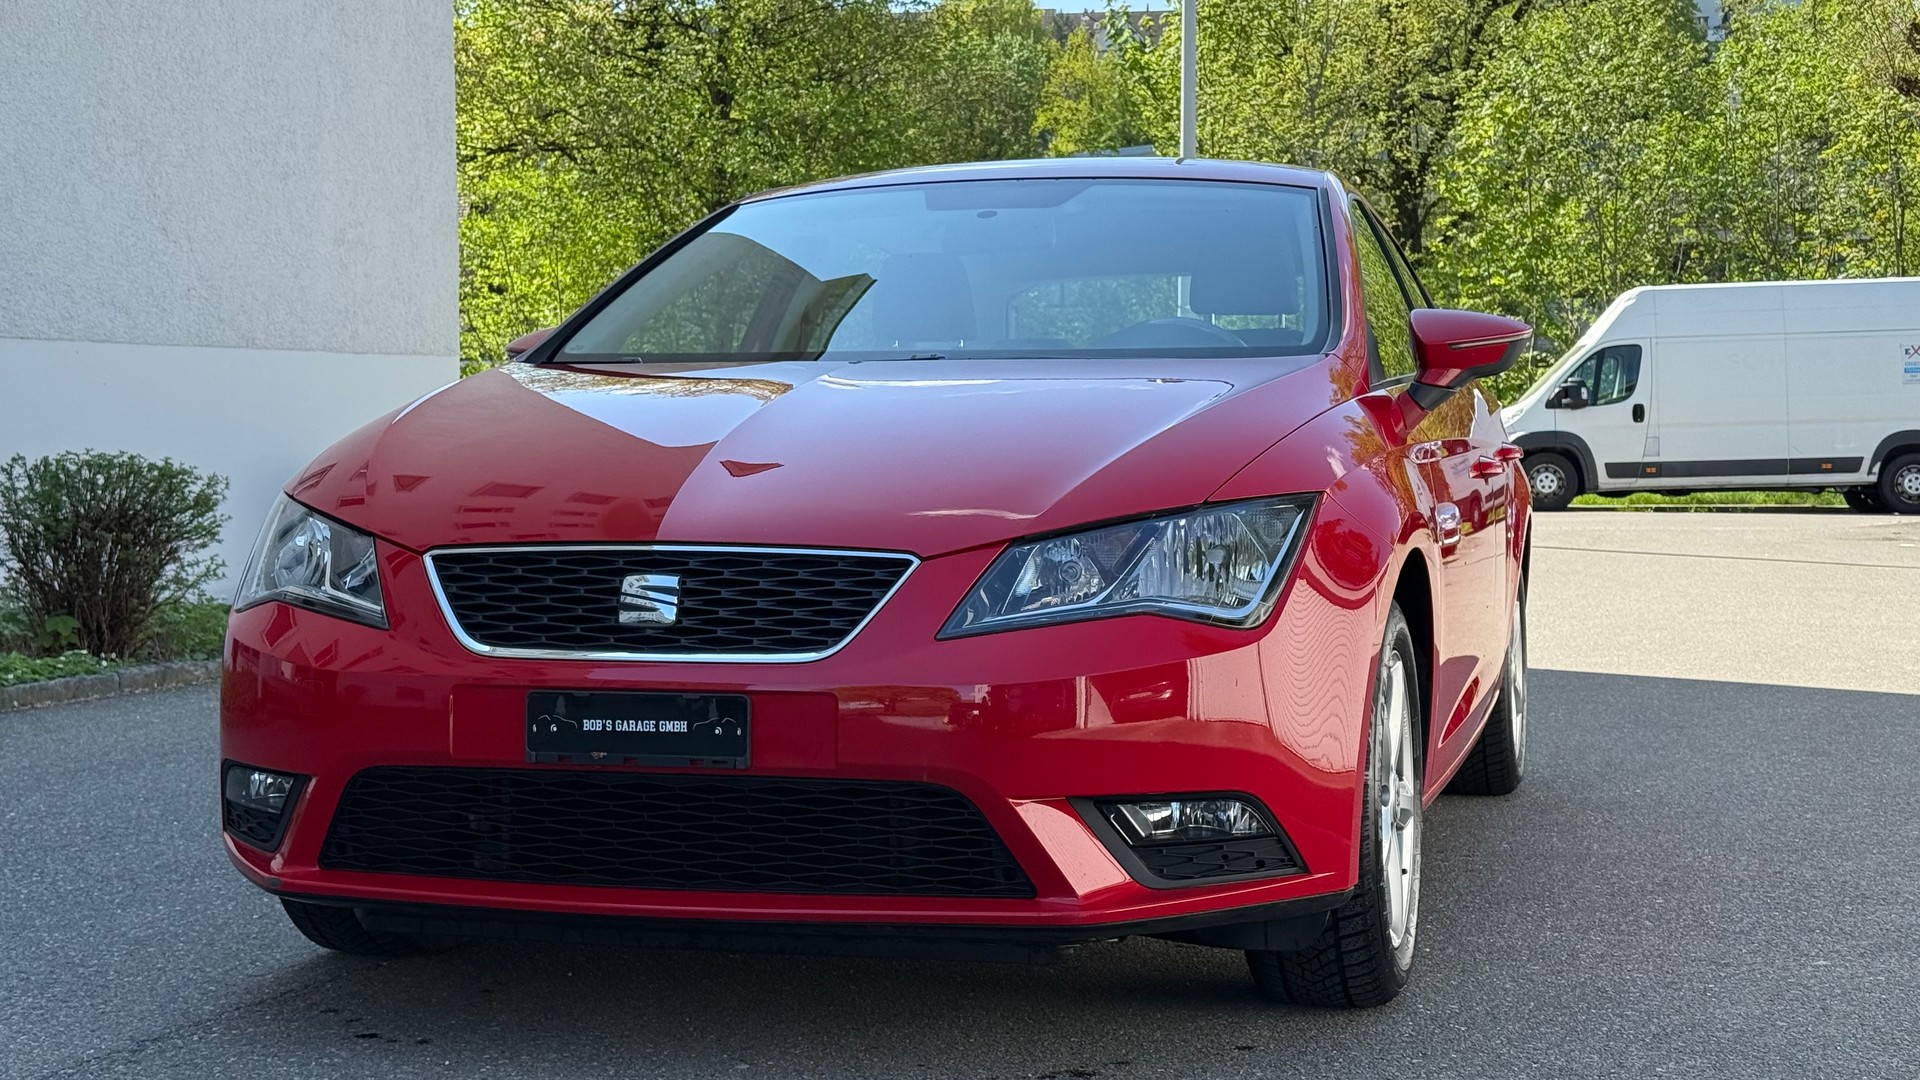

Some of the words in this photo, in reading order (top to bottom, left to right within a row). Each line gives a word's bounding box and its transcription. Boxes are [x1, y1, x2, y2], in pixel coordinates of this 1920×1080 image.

[583, 719, 612, 731] BOB'S
[615, 720, 656, 732] GARAGE
[659, 721, 688, 733] GMBH
